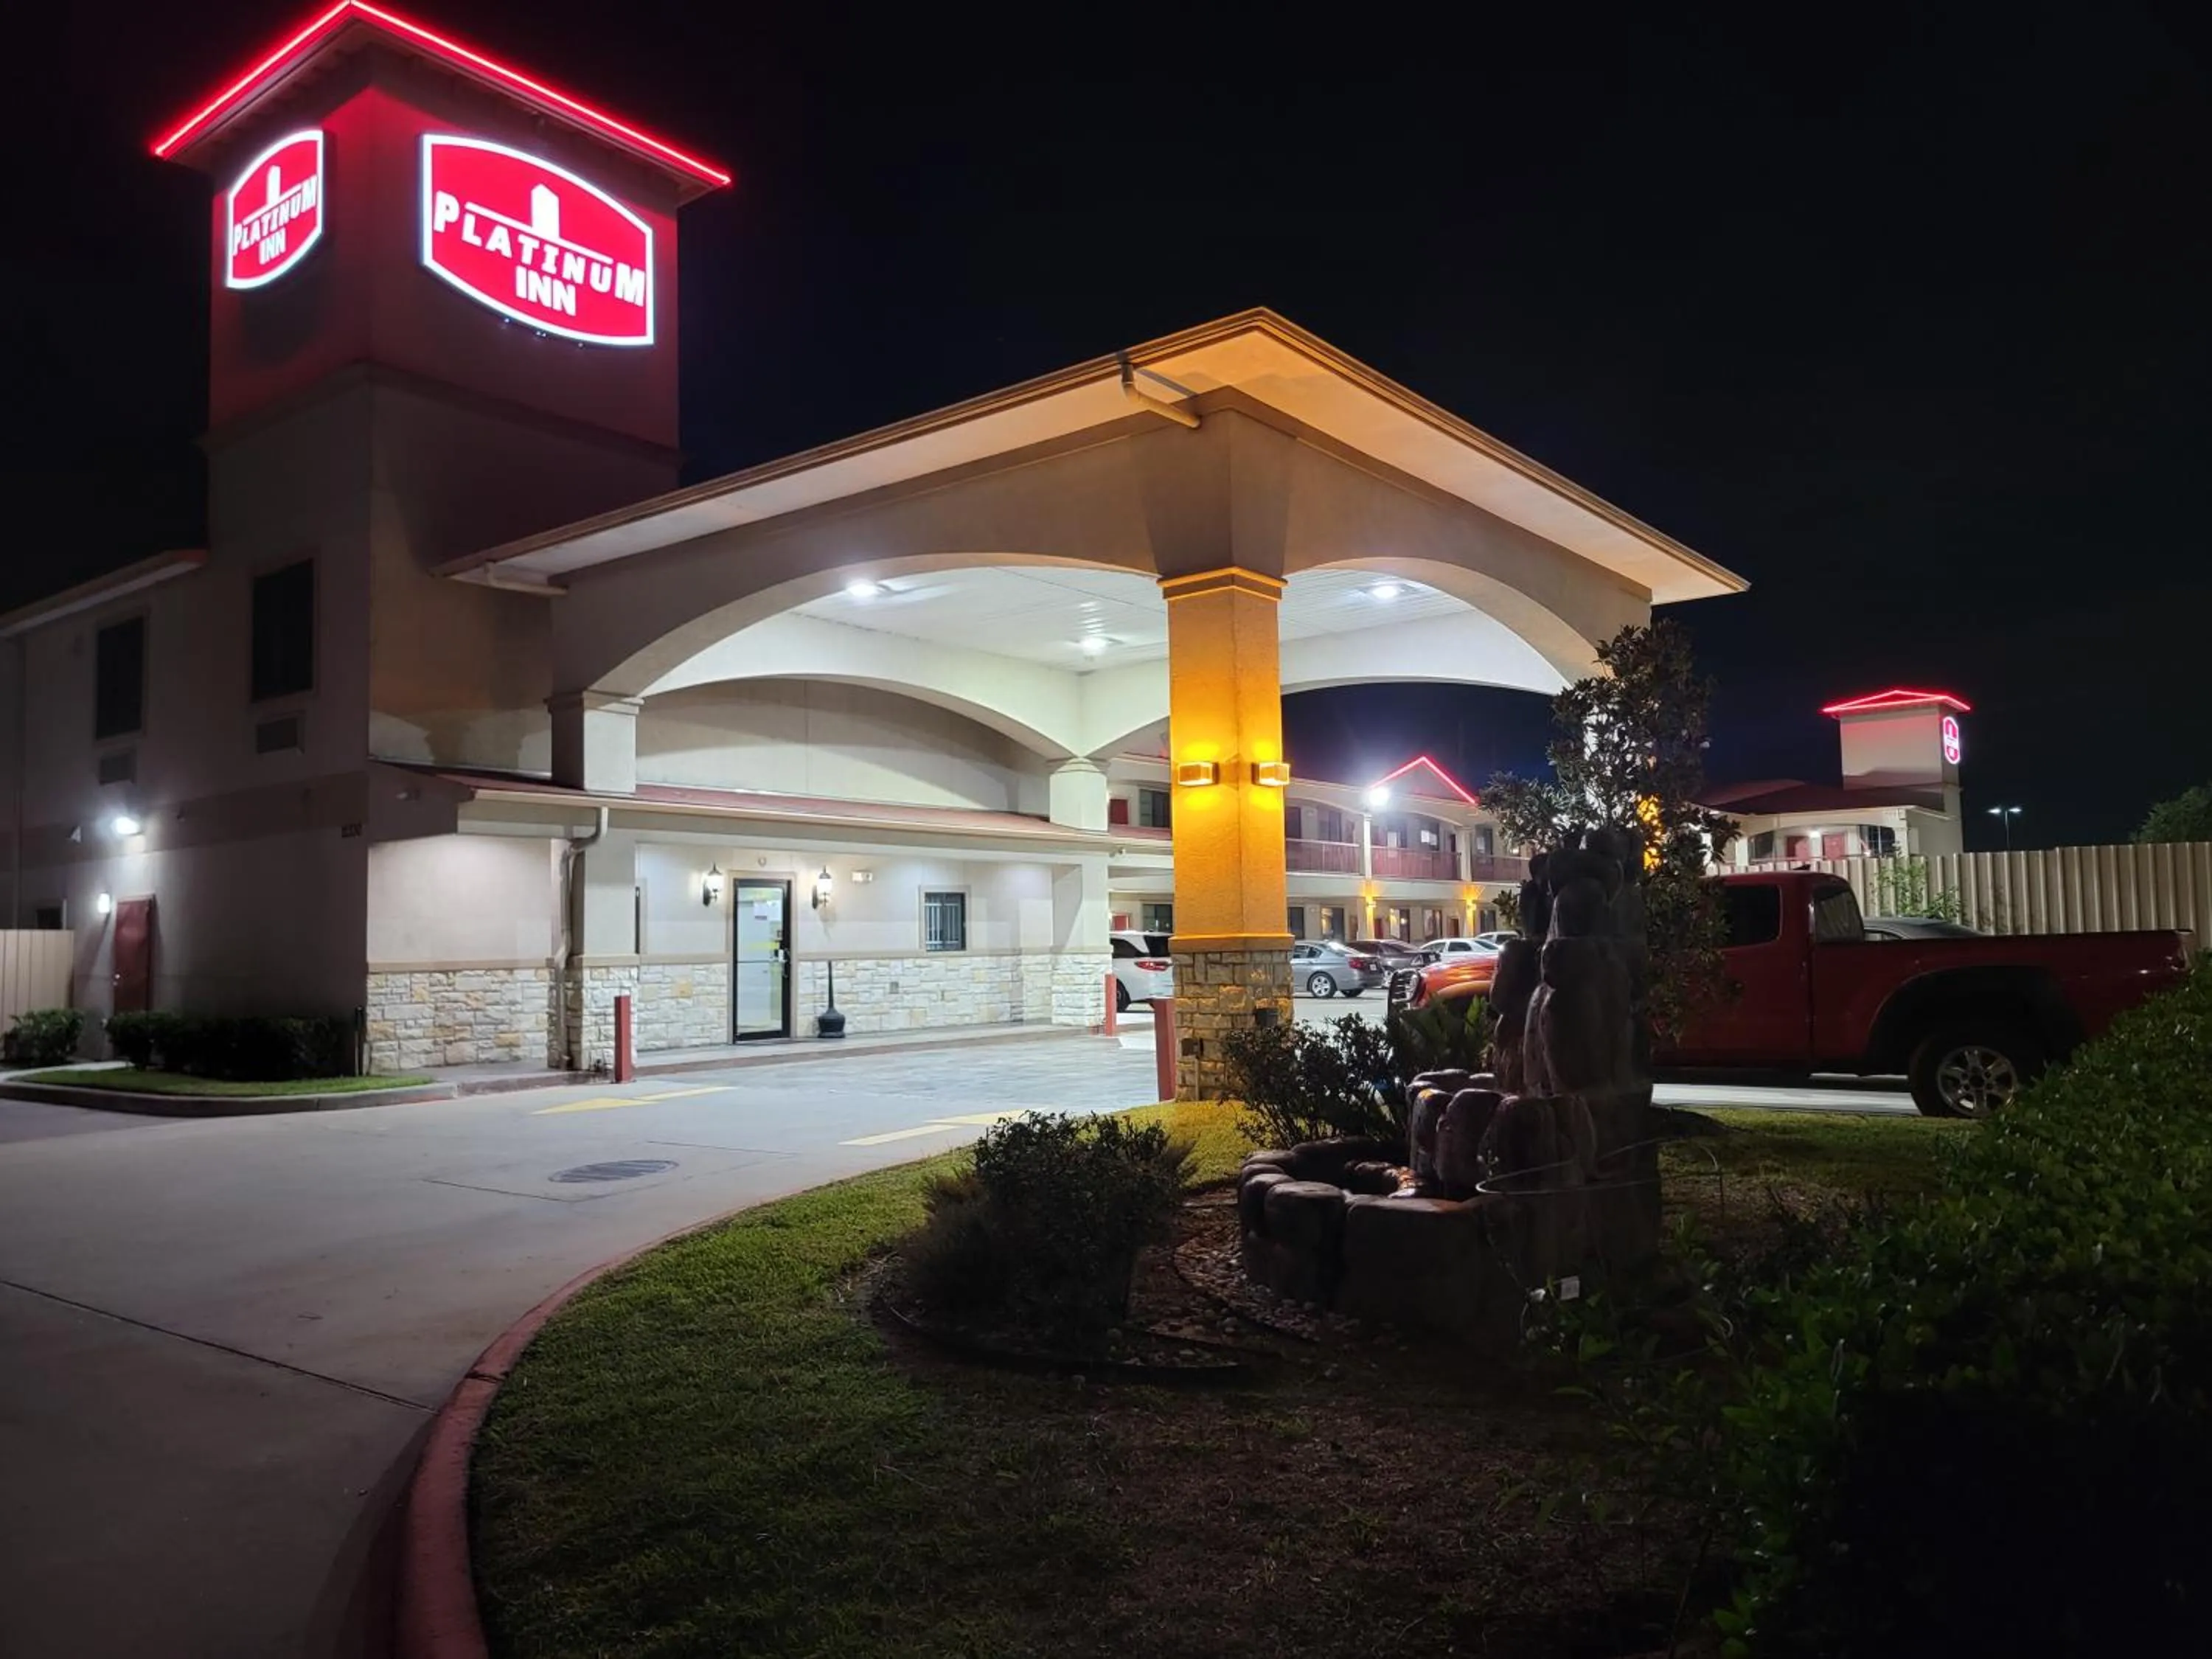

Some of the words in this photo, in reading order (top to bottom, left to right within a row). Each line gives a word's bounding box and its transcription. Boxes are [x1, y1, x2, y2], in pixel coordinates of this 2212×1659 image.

[232, 175, 318, 257] PLATINUM
[259, 227, 286, 265] INN
[433, 190, 645, 307] PLATINUM
[515, 265, 576, 316] INN
